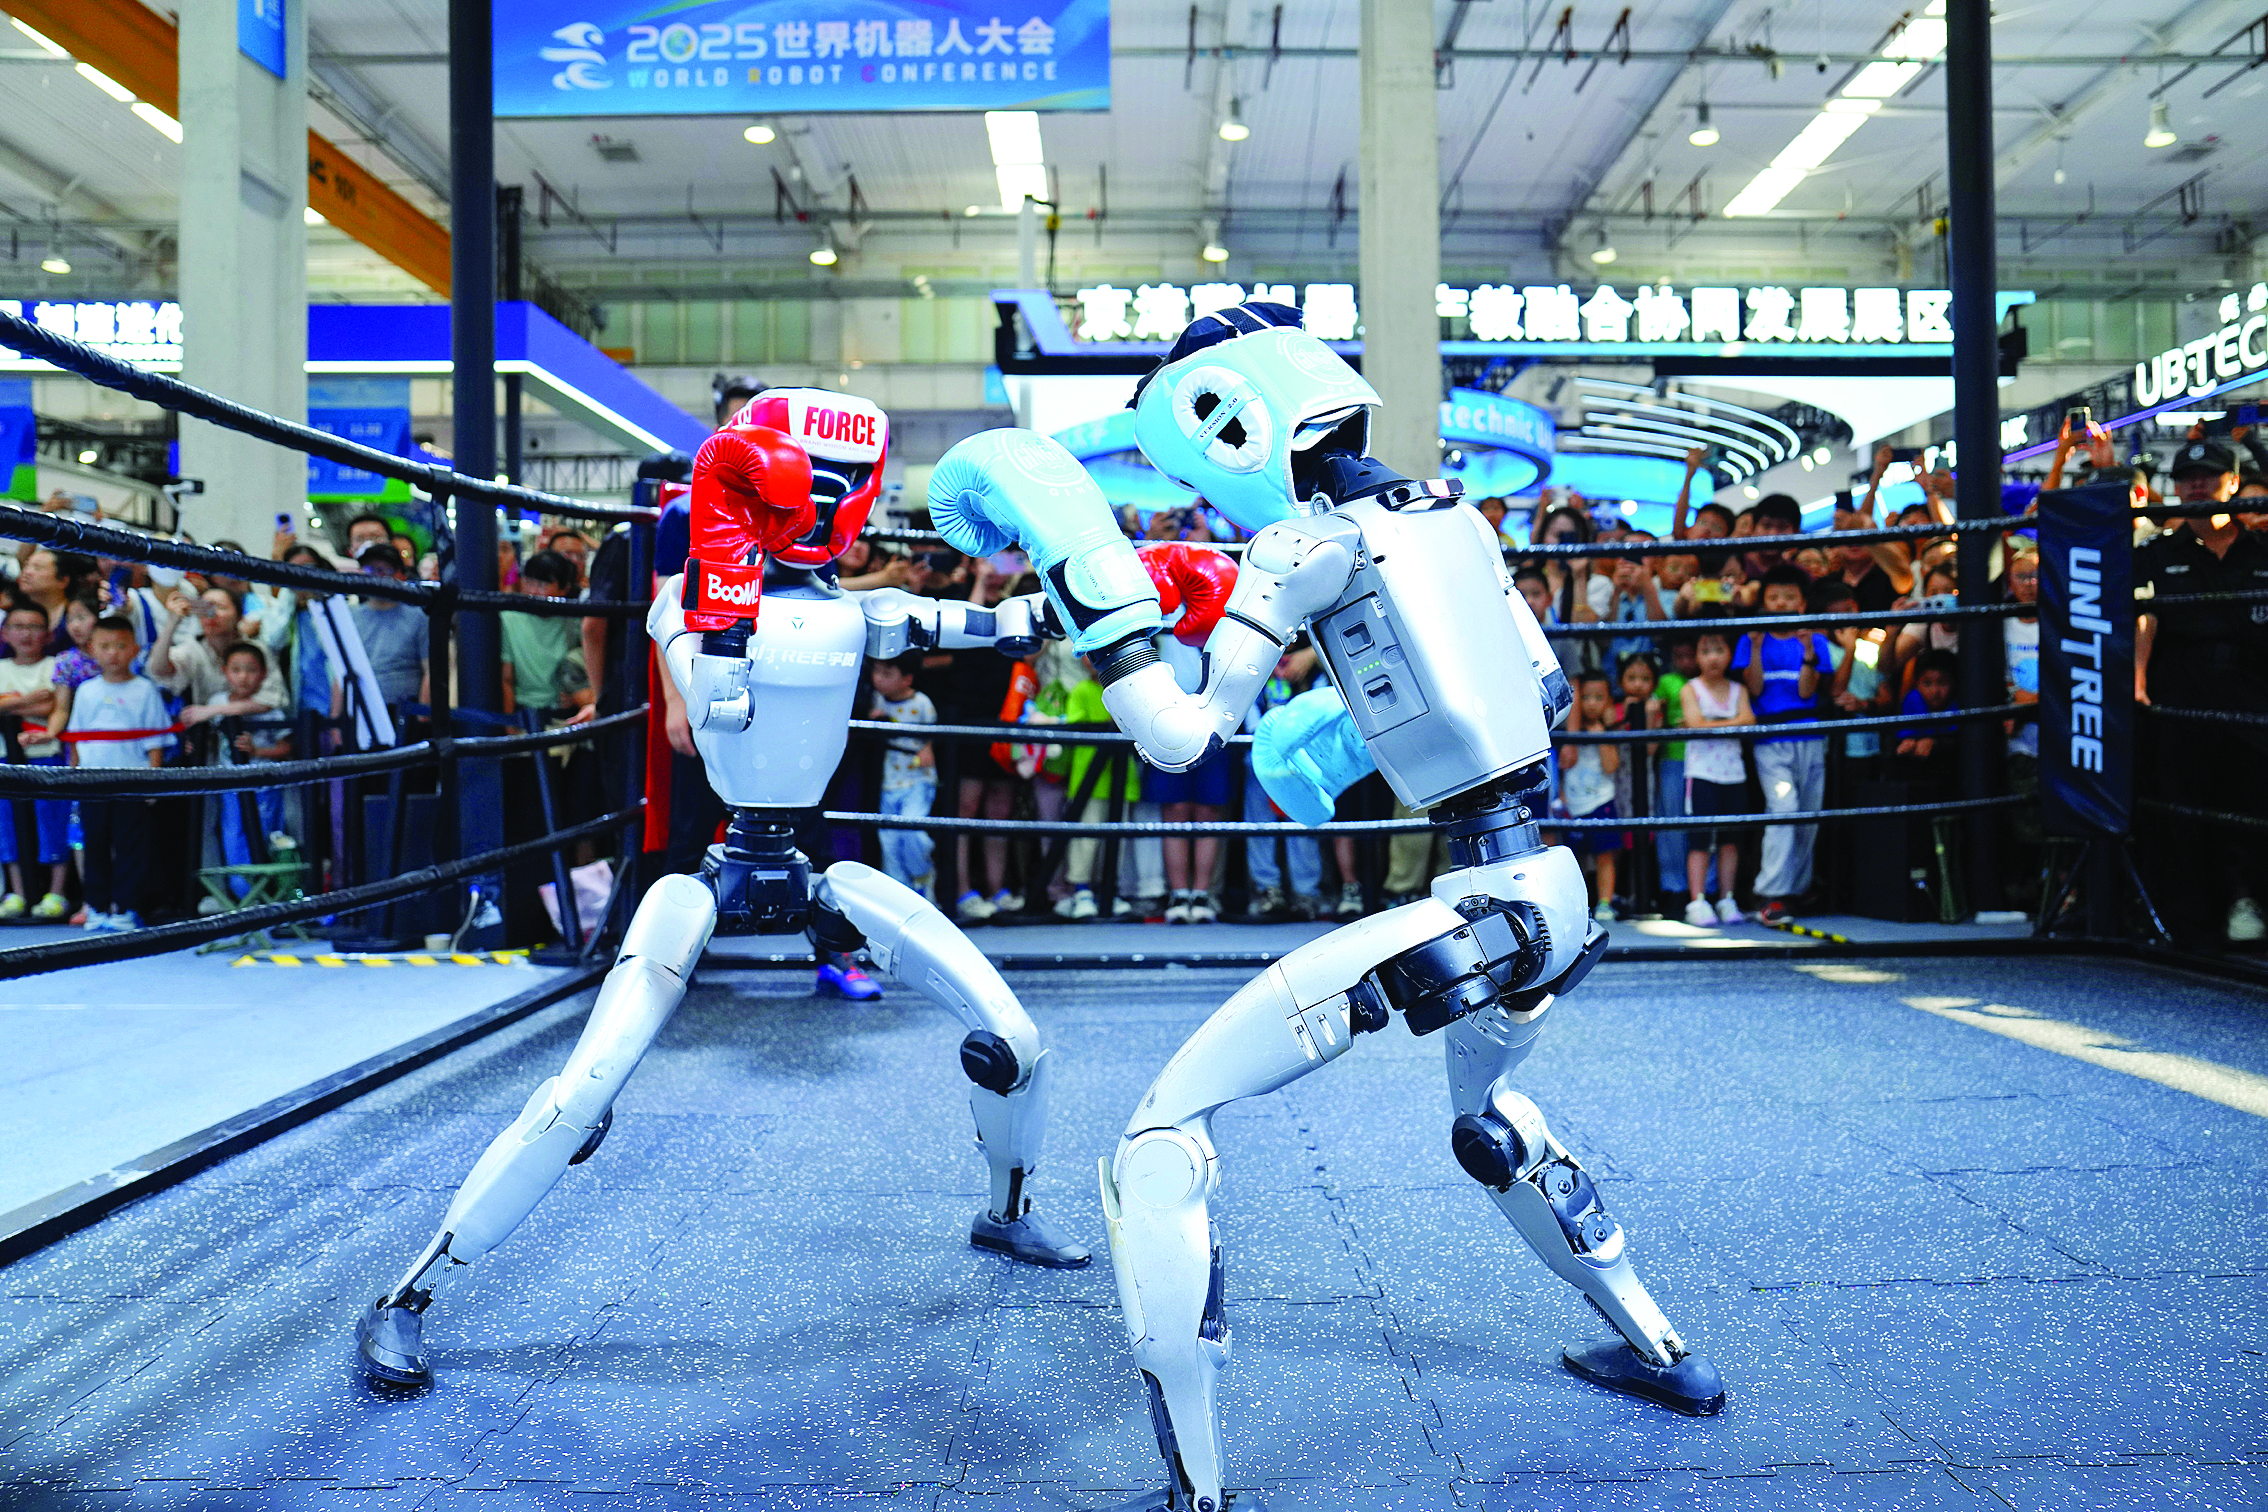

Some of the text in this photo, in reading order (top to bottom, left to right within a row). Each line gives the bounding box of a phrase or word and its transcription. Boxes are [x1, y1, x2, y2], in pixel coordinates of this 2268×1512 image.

[627, 16, 1056, 62] 2025世界机器人大会
[627, 61, 1058, 88] WORLD ROBOT CONFERENCE
[2135, 314, 2268, 407] UBTEC
[803, 405, 876, 446] FORCE
[1199, 410, 1226, 438] VERSION
[746, 643, 828, 665] NITREE
[2061, 547, 2113, 773] UNITREE
